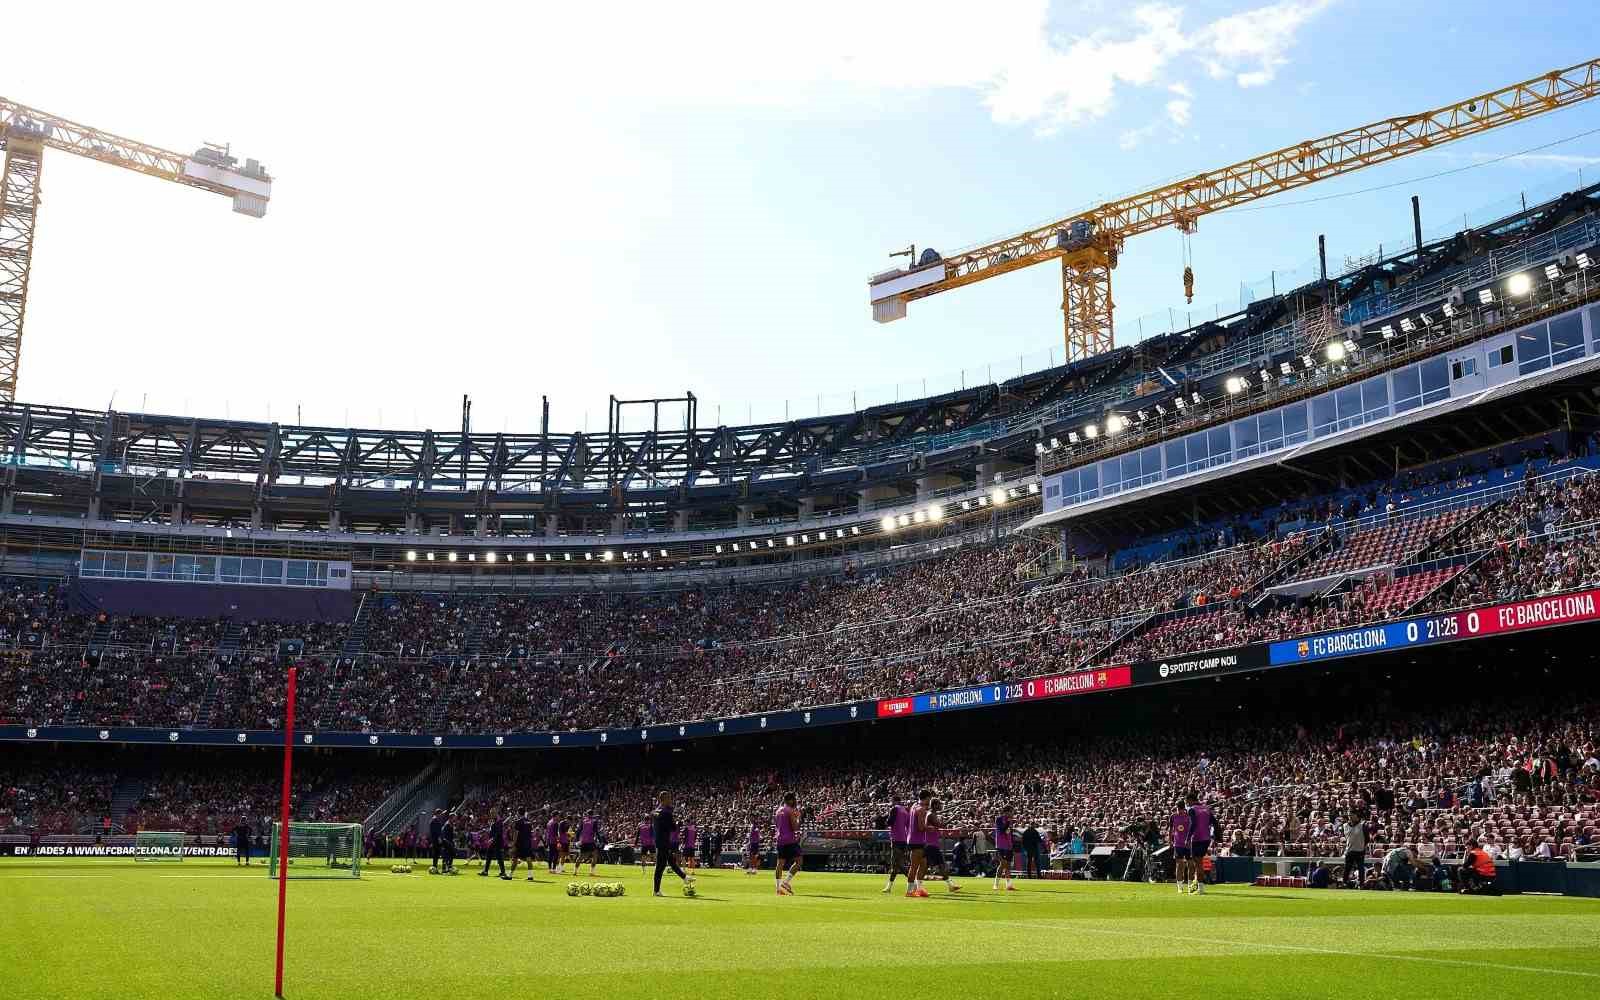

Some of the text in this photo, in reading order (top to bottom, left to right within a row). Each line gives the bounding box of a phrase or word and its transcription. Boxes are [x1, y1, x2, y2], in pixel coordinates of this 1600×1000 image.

[1313, 594, 1596, 656] FC BARCELONA 0 21:25 0 FC BARCELONA
[1169, 655, 1237, 674] SPOTIFY CAMP NOU
[939, 673, 1095, 708] FC BARCELONA 0 21:25 0 FC BARCELONA
[14, 846, 65, 855] ENADES
[66, 846, 73, 855] A
